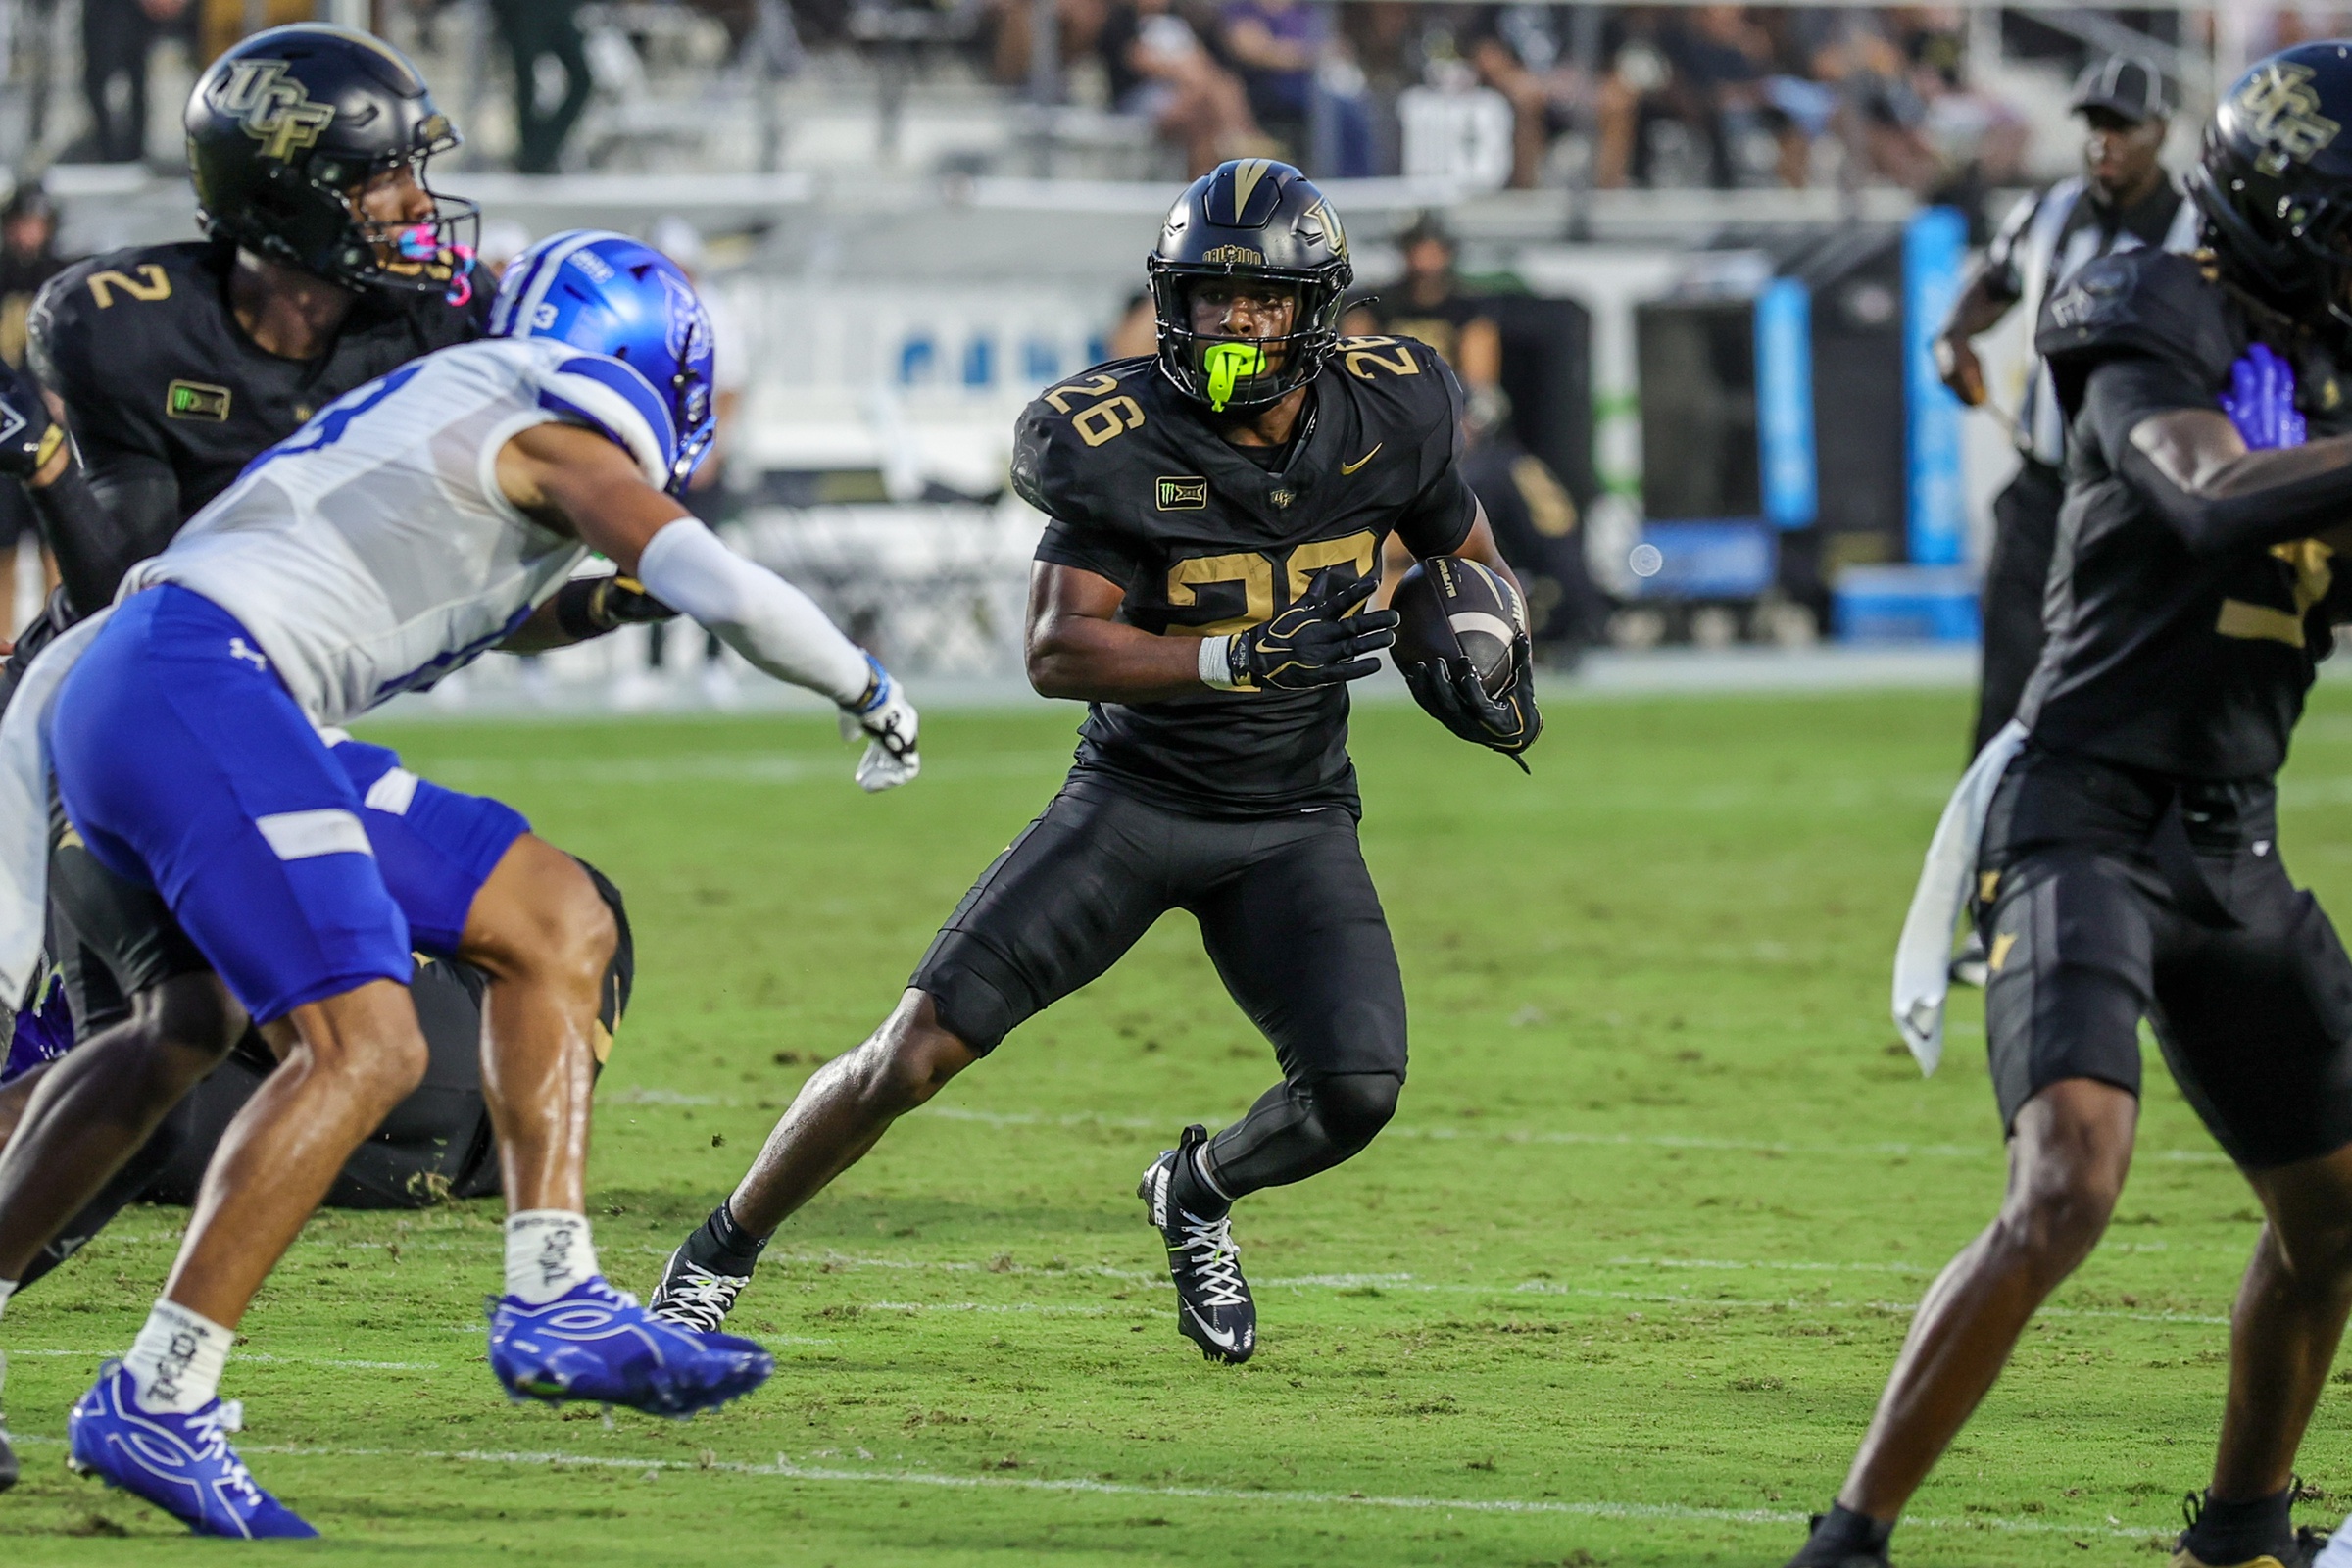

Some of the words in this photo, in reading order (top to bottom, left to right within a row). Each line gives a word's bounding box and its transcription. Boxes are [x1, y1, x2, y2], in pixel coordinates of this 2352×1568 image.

[204, 58, 336, 165] UCF
[87, 264, 172, 309] 2
[1201, 244, 1261, 265] ORLNDO
[1044, 374, 1146, 447] 26
[1154, 1165, 1170, 1230] NIKE
